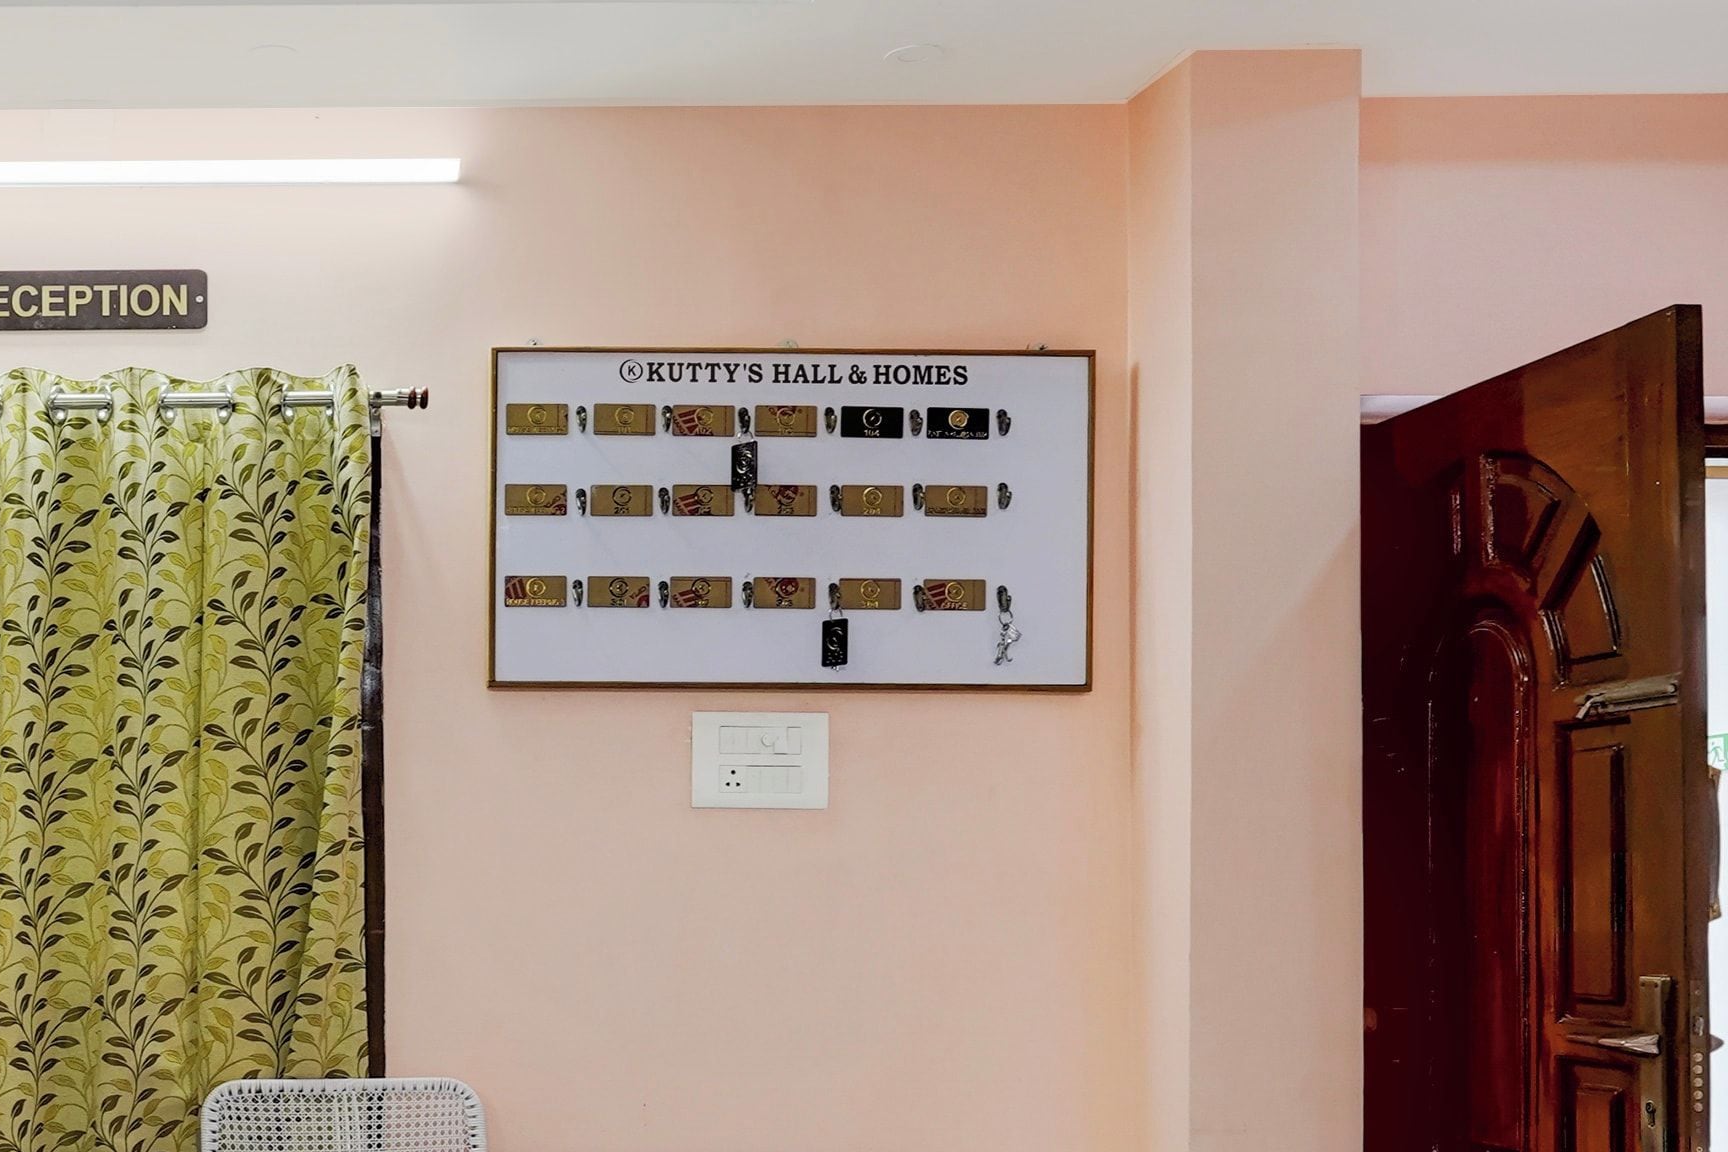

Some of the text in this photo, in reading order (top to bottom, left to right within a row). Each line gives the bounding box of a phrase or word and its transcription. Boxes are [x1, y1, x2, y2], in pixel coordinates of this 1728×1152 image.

[646, 361, 763, 384] KUTTY'S
[771, 363, 844, 385] HALL
[848, 364, 868, 385] &
[872, 364, 969, 386] HOMES
